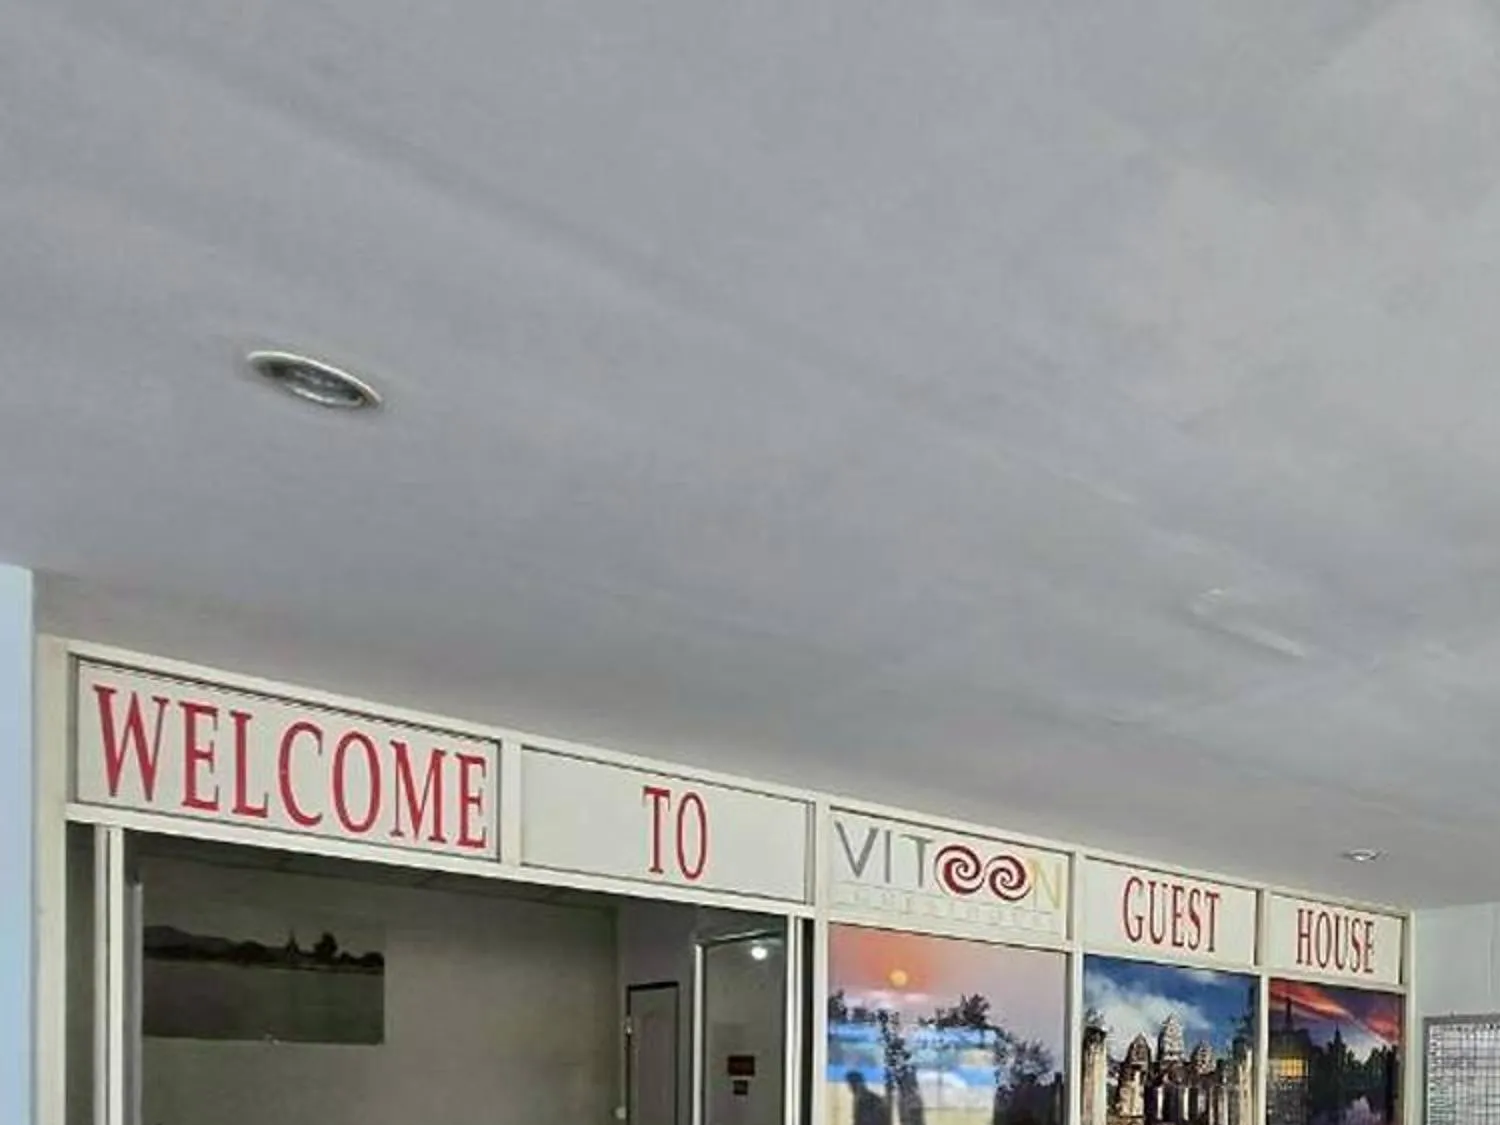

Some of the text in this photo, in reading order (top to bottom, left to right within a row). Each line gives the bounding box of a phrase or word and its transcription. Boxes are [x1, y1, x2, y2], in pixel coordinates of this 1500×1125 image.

[93, 684, 488, 850] WELCOME
[643, 785, 708, 880] TO
[1123, 876, 1221, 952] GUEST
[1296, 907, 1375, 974] HOUSE
